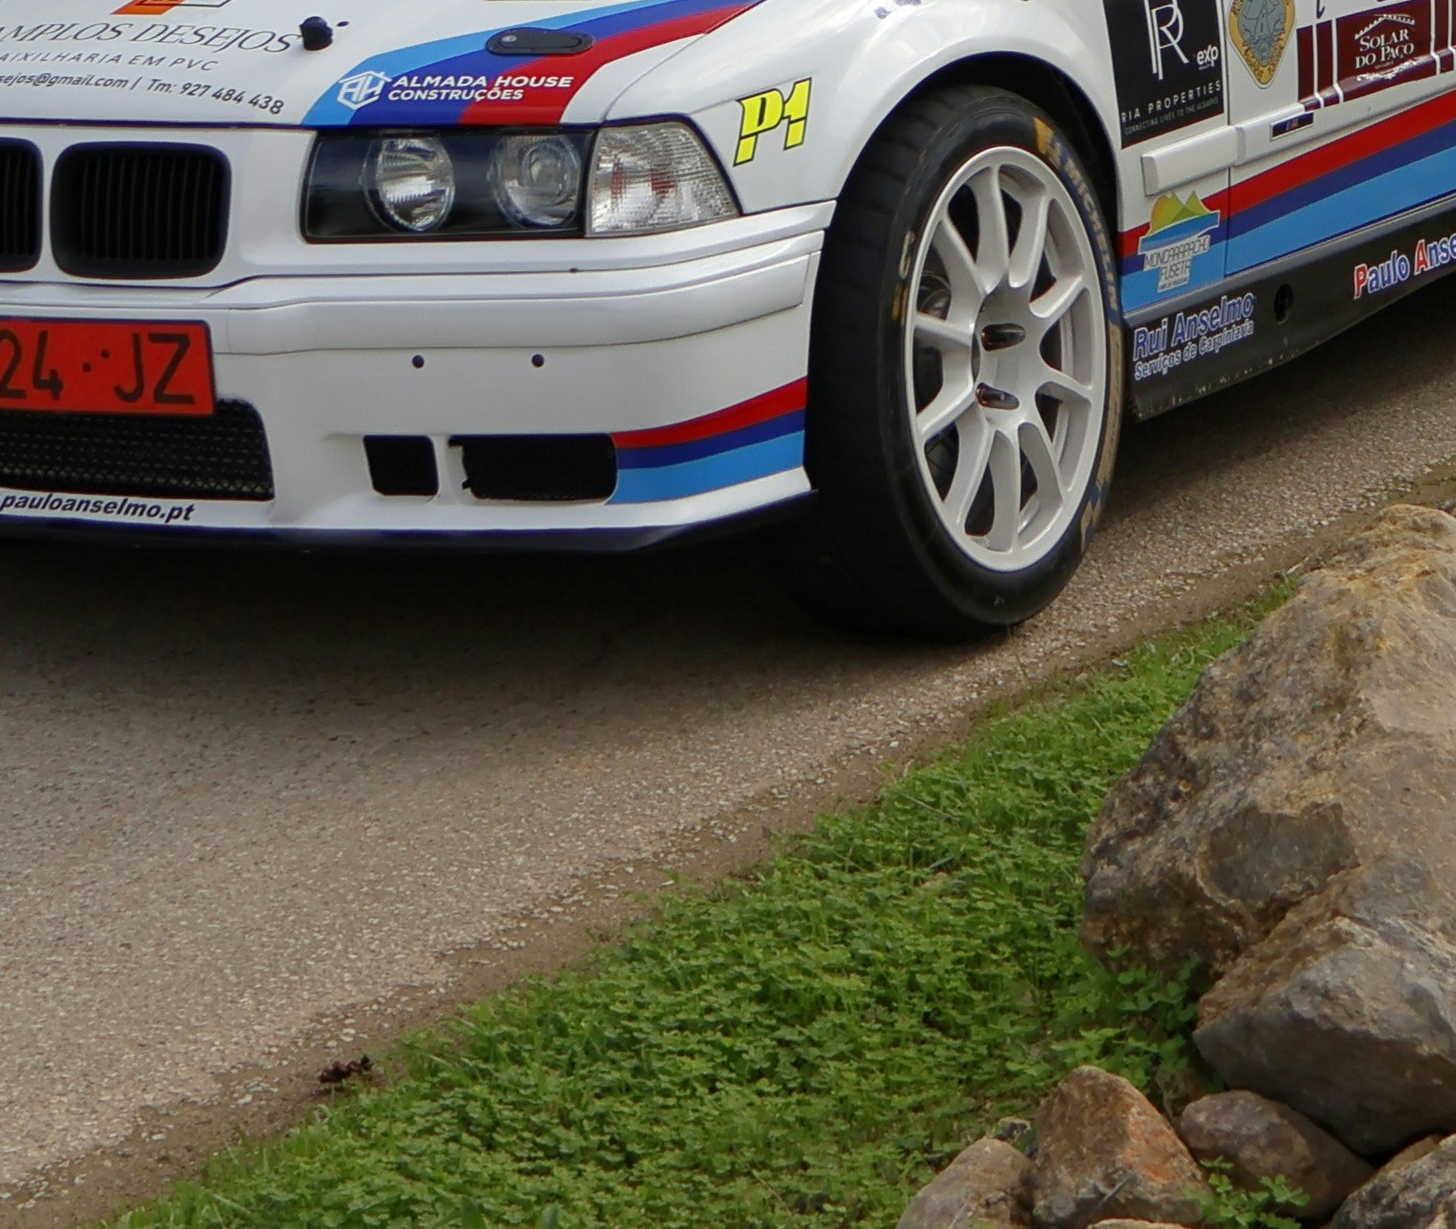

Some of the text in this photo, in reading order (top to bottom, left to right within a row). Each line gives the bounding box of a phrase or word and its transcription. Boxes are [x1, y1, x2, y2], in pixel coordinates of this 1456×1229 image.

[130, 23, 301, 54] DESEJOS
[1359, 28, 1410, 52] SOLAR
[128, 53, 164, 68] EM
[169, 56, 219, 72] PVC
[1355, 53, 1376, 70] DO
[1380, 43, 1415, 61] PAÇO
[146, 78, 178, 93] Tm:
[179, 82, 210, 99] 927
[211, 85, 247, 105] 484
[248, 93, 285, 115] 438
[388, 87, 524, 102] CONSTRUÇÕES
[392, 75, 575, 88] ALMADA HOUSE
[1121, 79, 1221, 123] RIA PROPERTIES
[733, 77, 812, 166] P1
[1353, 249, 1411, 300] Paulo
[1132, 292, 1255, 362] Rui Anselmo
[1134, 320, 1255, 382] Serviços de Carpintaria
